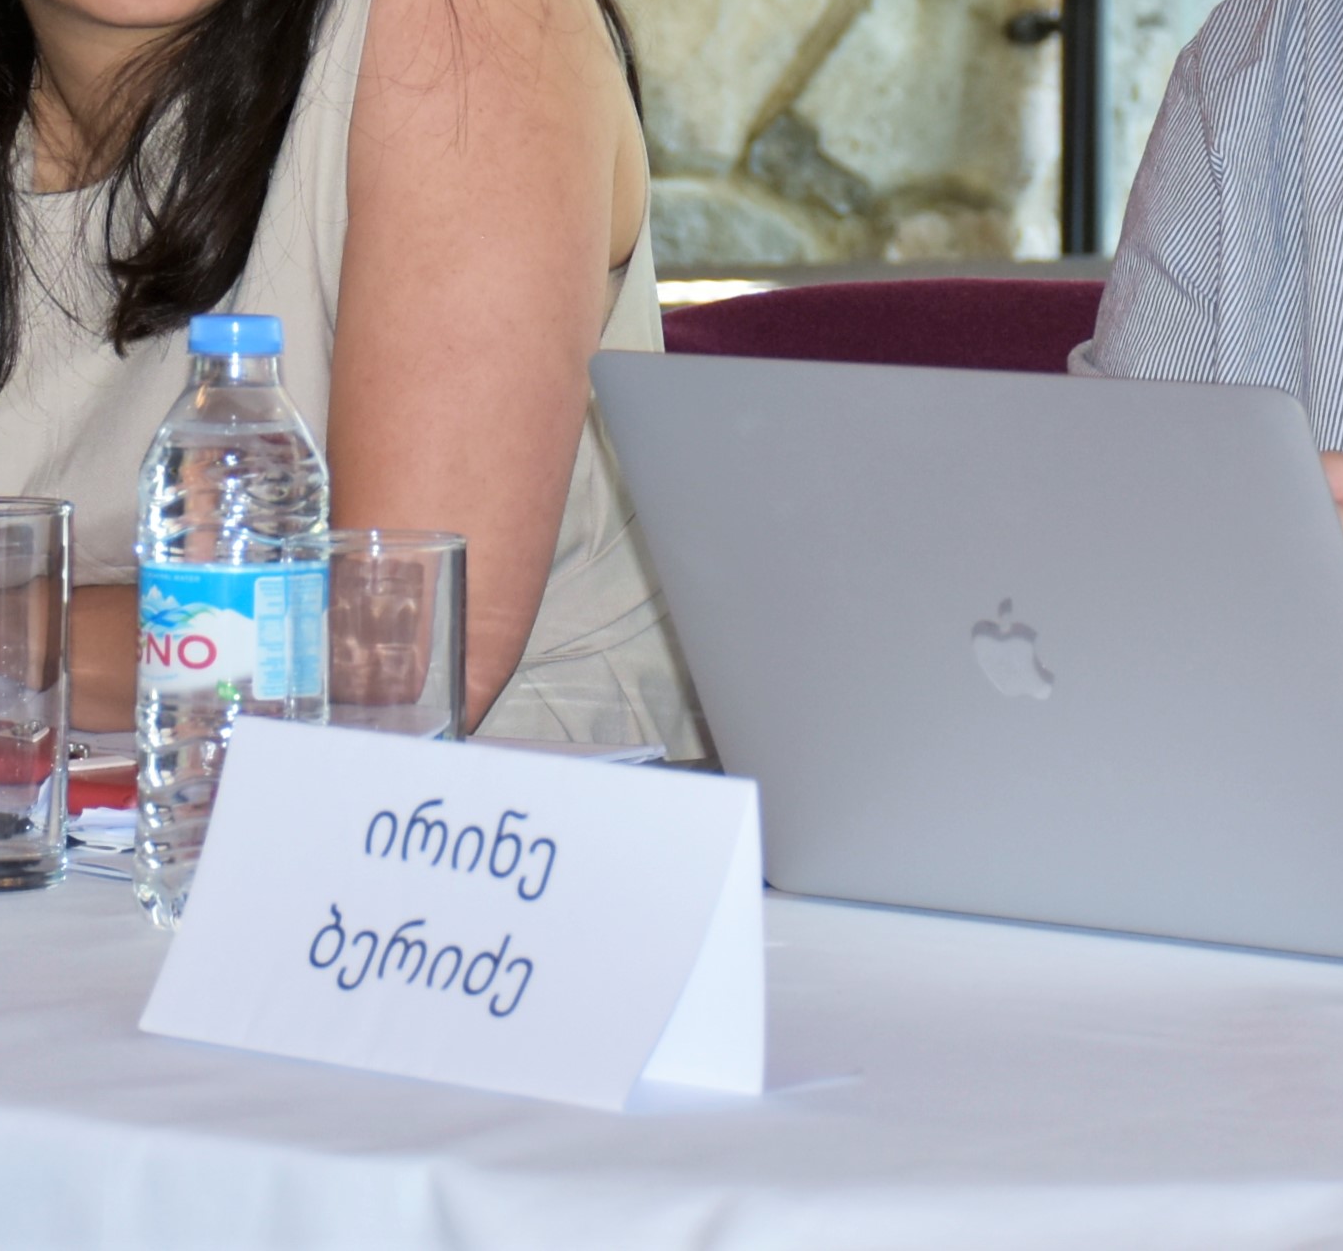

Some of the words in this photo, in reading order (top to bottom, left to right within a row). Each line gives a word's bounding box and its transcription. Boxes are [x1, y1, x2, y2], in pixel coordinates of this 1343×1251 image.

[138, 631, 218, 670] NO
[364, 798, 557, 902] ირინე
[308, 903, 535, 1018] ბერიძე
